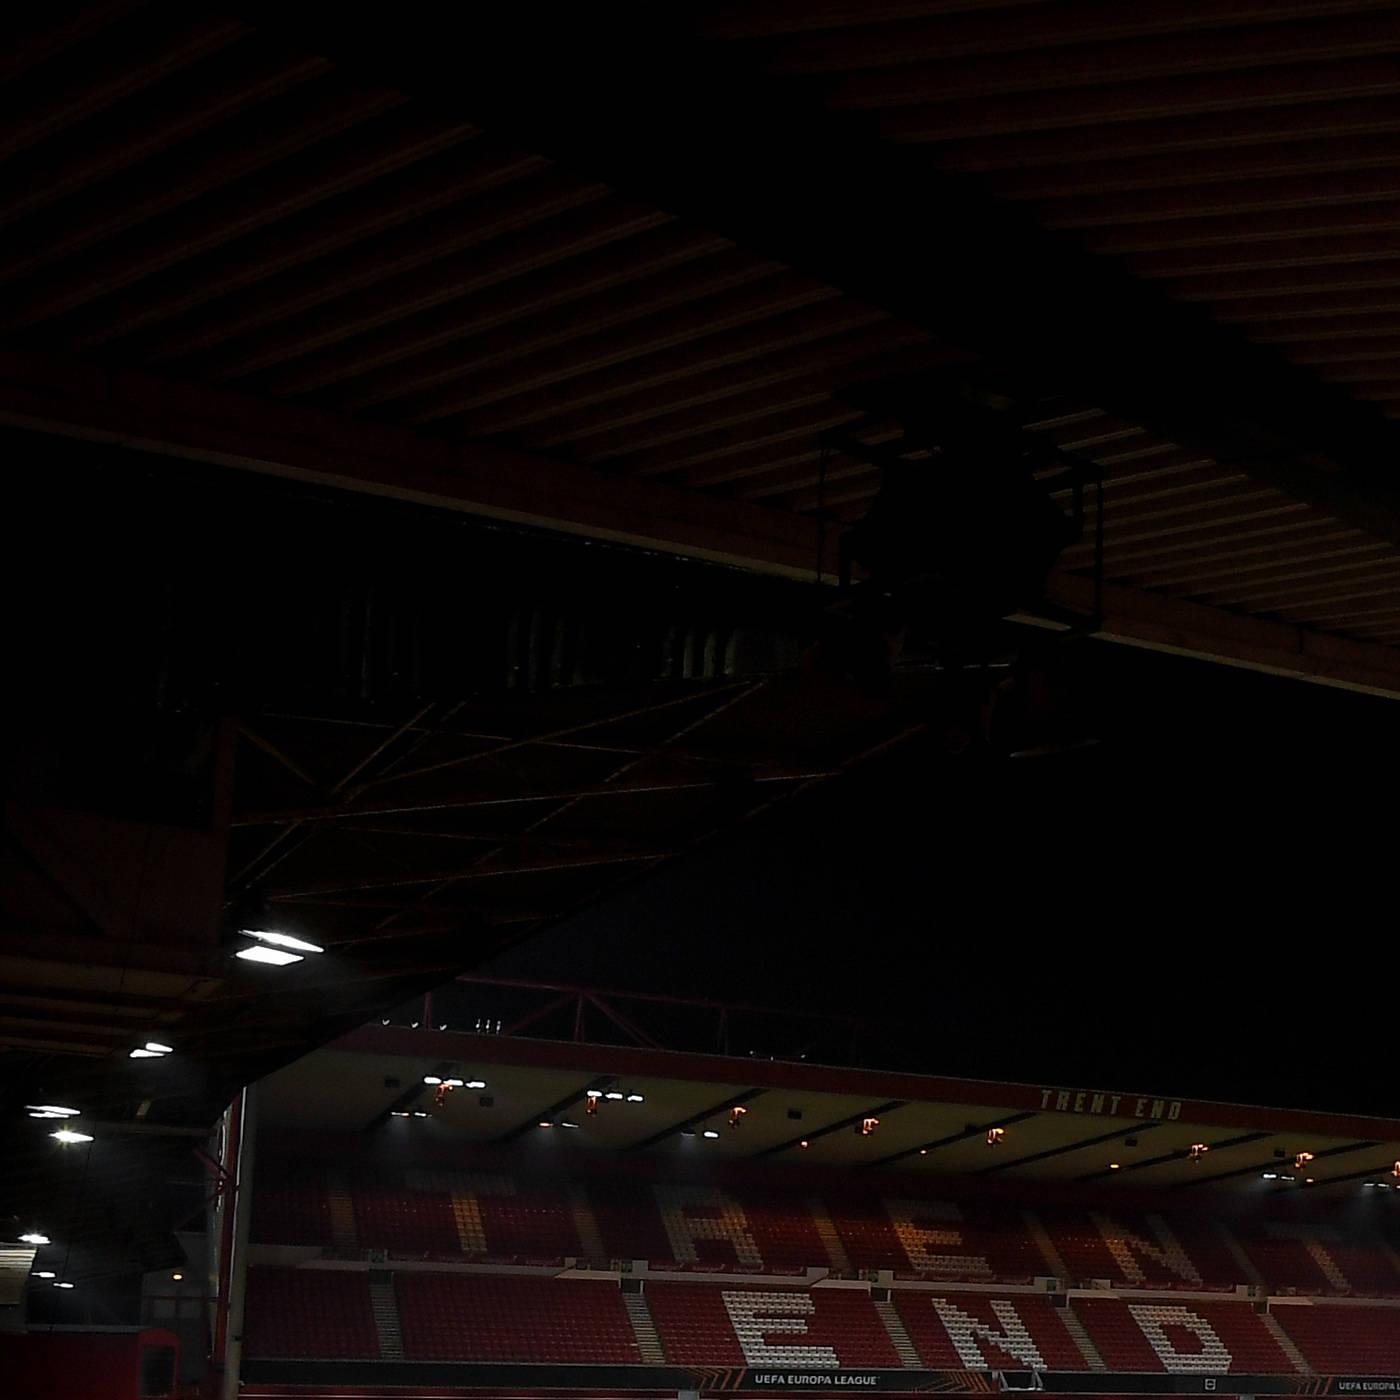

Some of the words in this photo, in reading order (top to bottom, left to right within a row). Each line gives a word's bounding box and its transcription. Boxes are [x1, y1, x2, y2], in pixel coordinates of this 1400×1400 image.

[1040, 1089, 1122, 1115] TRENT
[1135, 1097, 1182, 1120] END
[722, 1290, 1232, 1374] END
[754, 1374, 785, 1384] UEFA
[787, 1375, 832, 1385] EUROPA
[834, 1375, 877, 1385] LEAGUE
